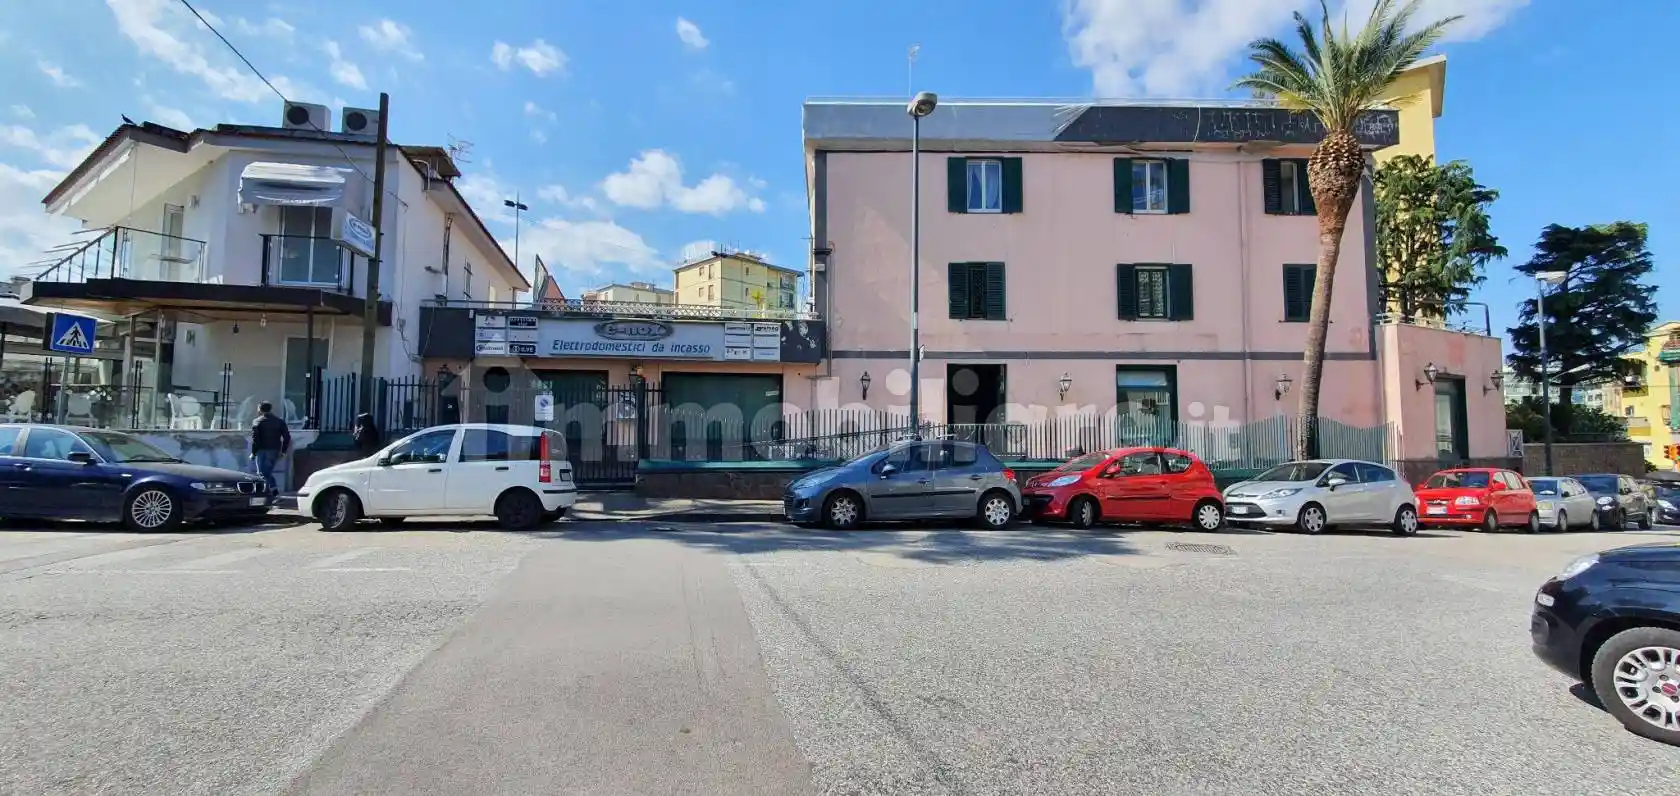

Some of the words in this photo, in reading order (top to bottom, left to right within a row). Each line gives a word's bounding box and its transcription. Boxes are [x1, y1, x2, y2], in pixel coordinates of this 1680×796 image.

[552, 339, 646, 353] Elettrodomestici
[652, 341, 665, 353] da
[671, 342, 711, 354] incasso
